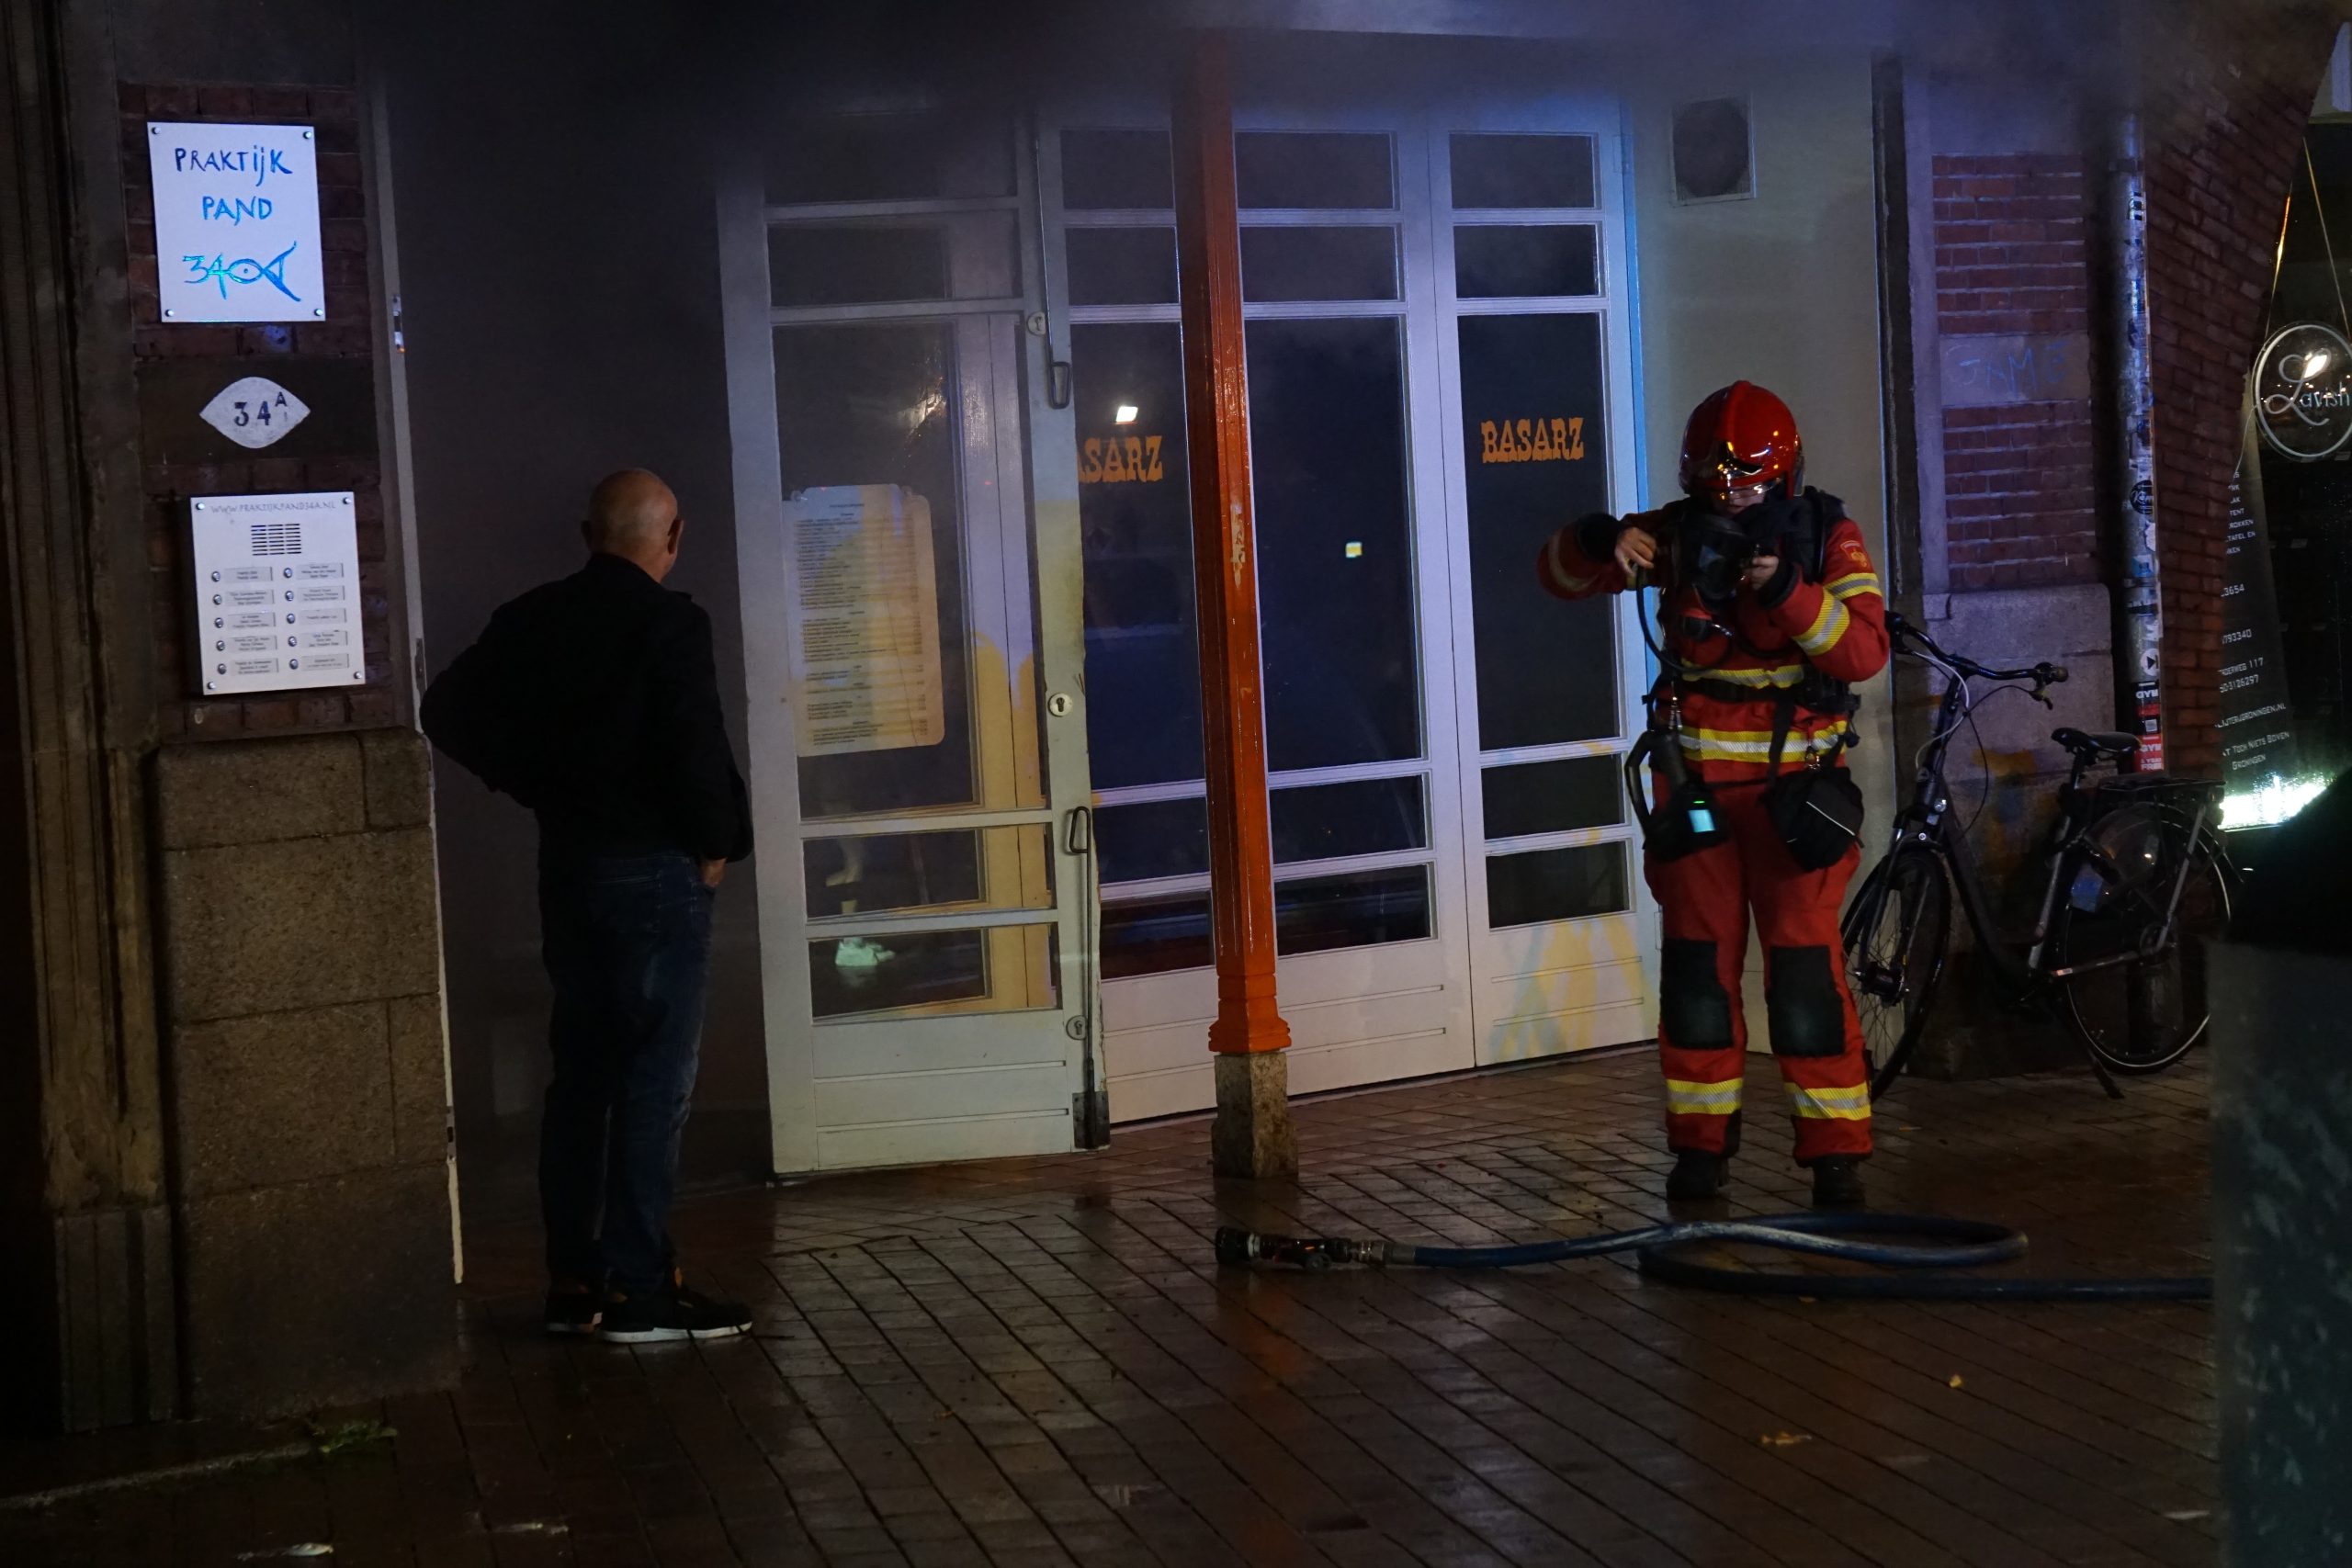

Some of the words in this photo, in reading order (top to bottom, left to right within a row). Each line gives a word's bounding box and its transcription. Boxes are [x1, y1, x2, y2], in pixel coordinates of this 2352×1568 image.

[202, 196, 273, 227] PAND
[1480, 416, 1585, 464] BASARZ
[2220, 582, 2245, 597] 3654
[2222, 628, 2253, 645] 793340
[2249, 656, 2265, 670] 117
